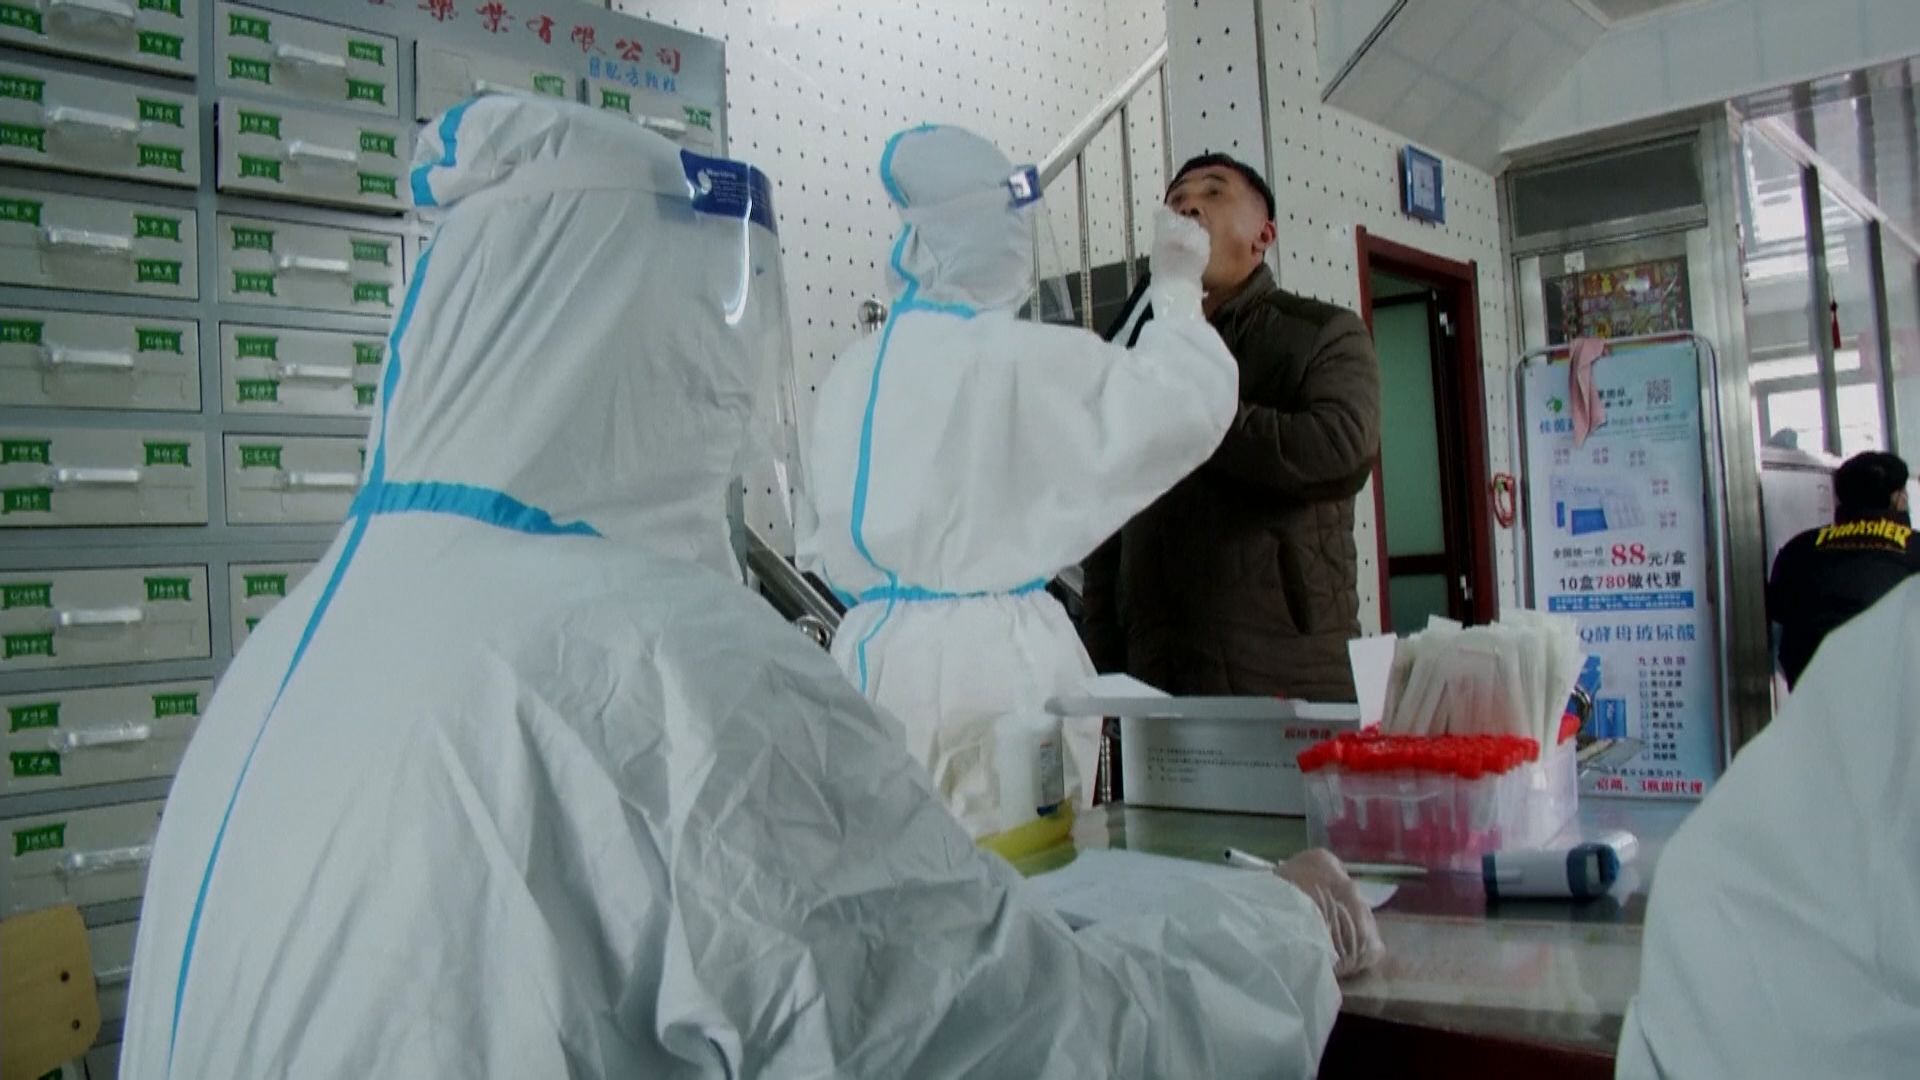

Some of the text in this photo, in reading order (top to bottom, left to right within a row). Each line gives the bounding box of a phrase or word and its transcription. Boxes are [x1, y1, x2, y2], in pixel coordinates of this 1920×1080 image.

[1815, 517, 1911, 549] THRASHER
[1560, 571, 1682, 591] 10盒780做代理
